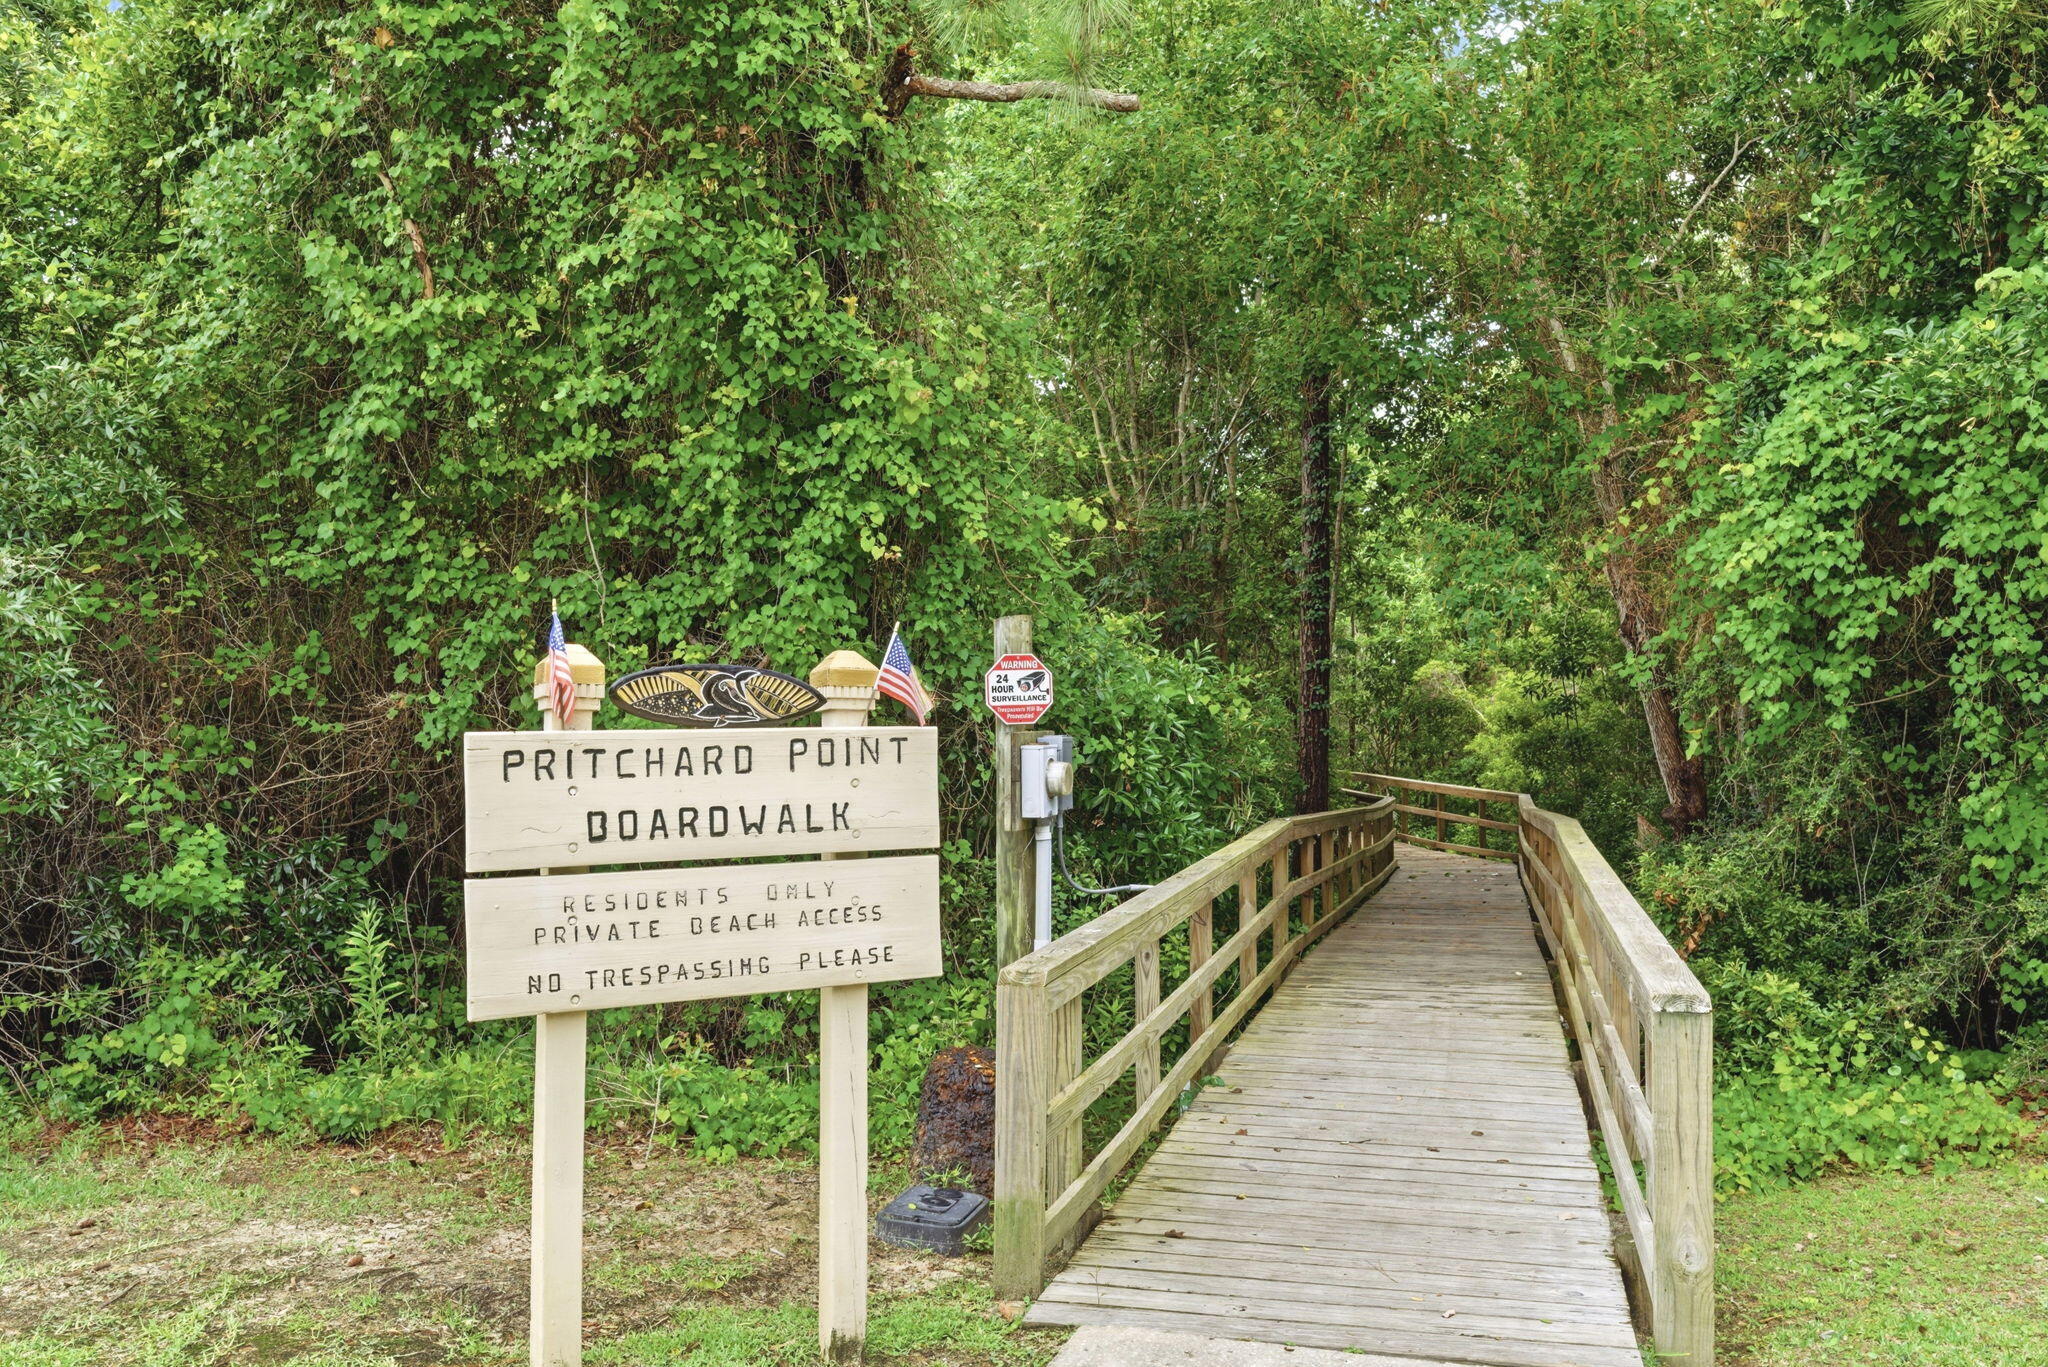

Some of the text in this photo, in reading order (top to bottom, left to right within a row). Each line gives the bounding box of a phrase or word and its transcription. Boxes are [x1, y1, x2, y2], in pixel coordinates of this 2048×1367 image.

[996, 673, 1009, 684] 24
[1000, 660, 1038, 669] WARNING
[991, 685, 1014, 693] HOUR
[992, 694, 1047, 703] SURVEILLANCE
[502, 736, 909, 782] PRITCHARD POINT
[586, 801, 851, 844] BOARDWALK
[563, 880, 834, 913] RESIDENTS ONLY
[534, 904, 882, 945] PRIVATE BEACH ACCESS
[527, 945, 894, 995] NO TRESPASSING PLEASE
